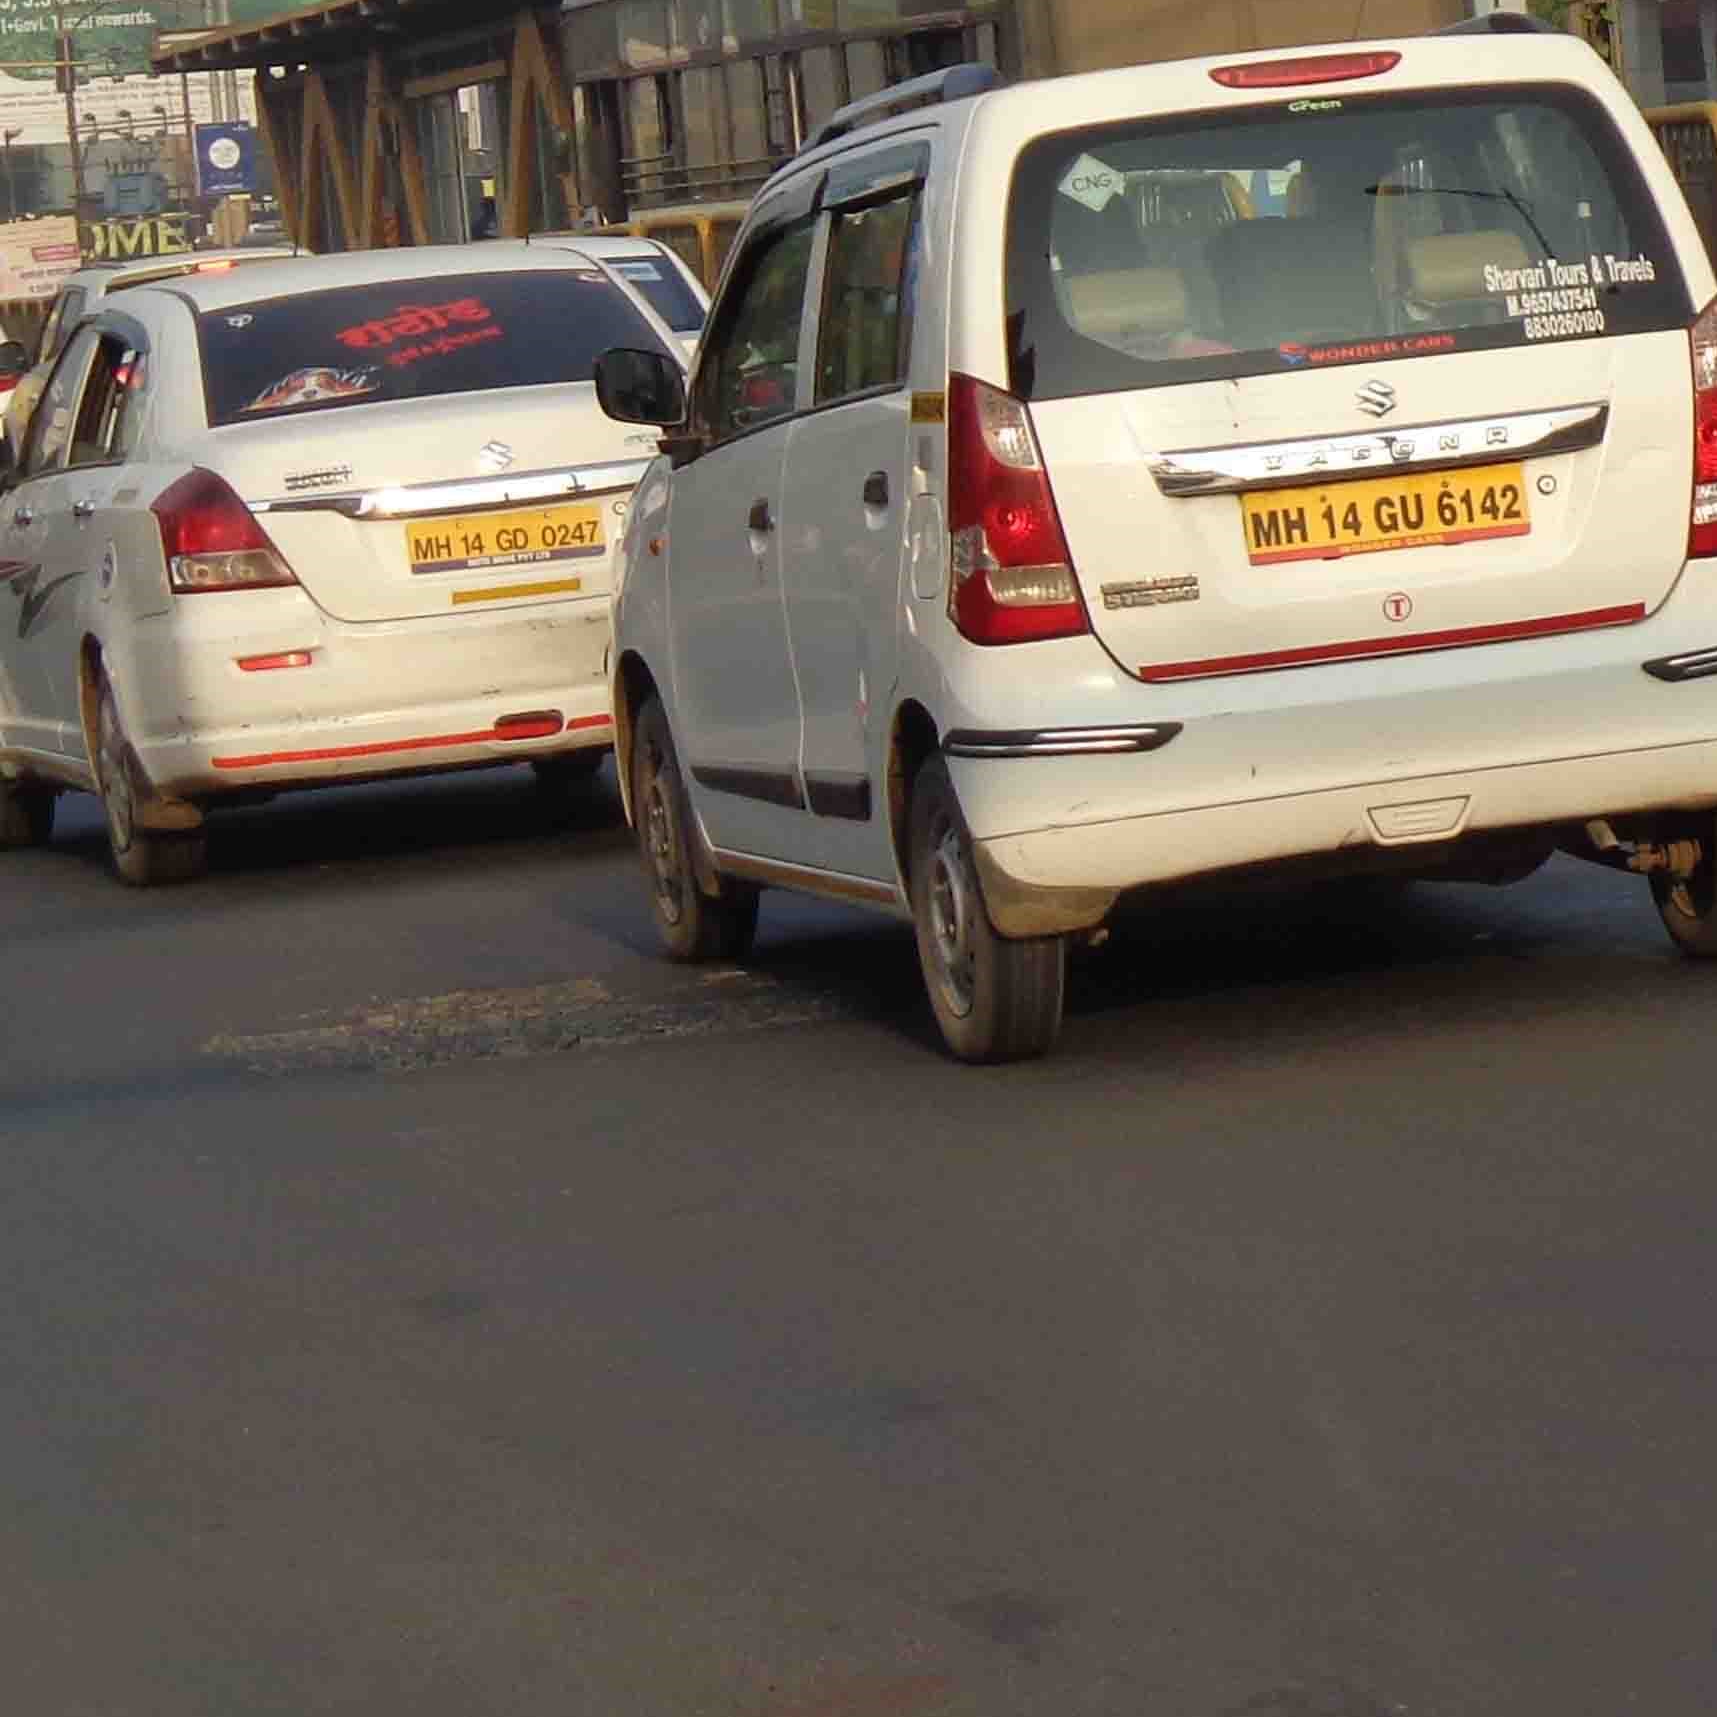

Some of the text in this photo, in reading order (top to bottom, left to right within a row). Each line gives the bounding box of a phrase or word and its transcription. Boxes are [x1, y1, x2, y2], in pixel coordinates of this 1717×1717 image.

[1288, 98, 1342, 113] Green
[1071, 173, 1112, 193] CNG
[1484, 253, 1655, 292] Sharvari Tours & Travels
[1250, 484, 1521, 549] MH 14 GU 6142
[413, 520, 599, 561] MH 14 GD 0247
[1390, 599, 1406, 617] T
